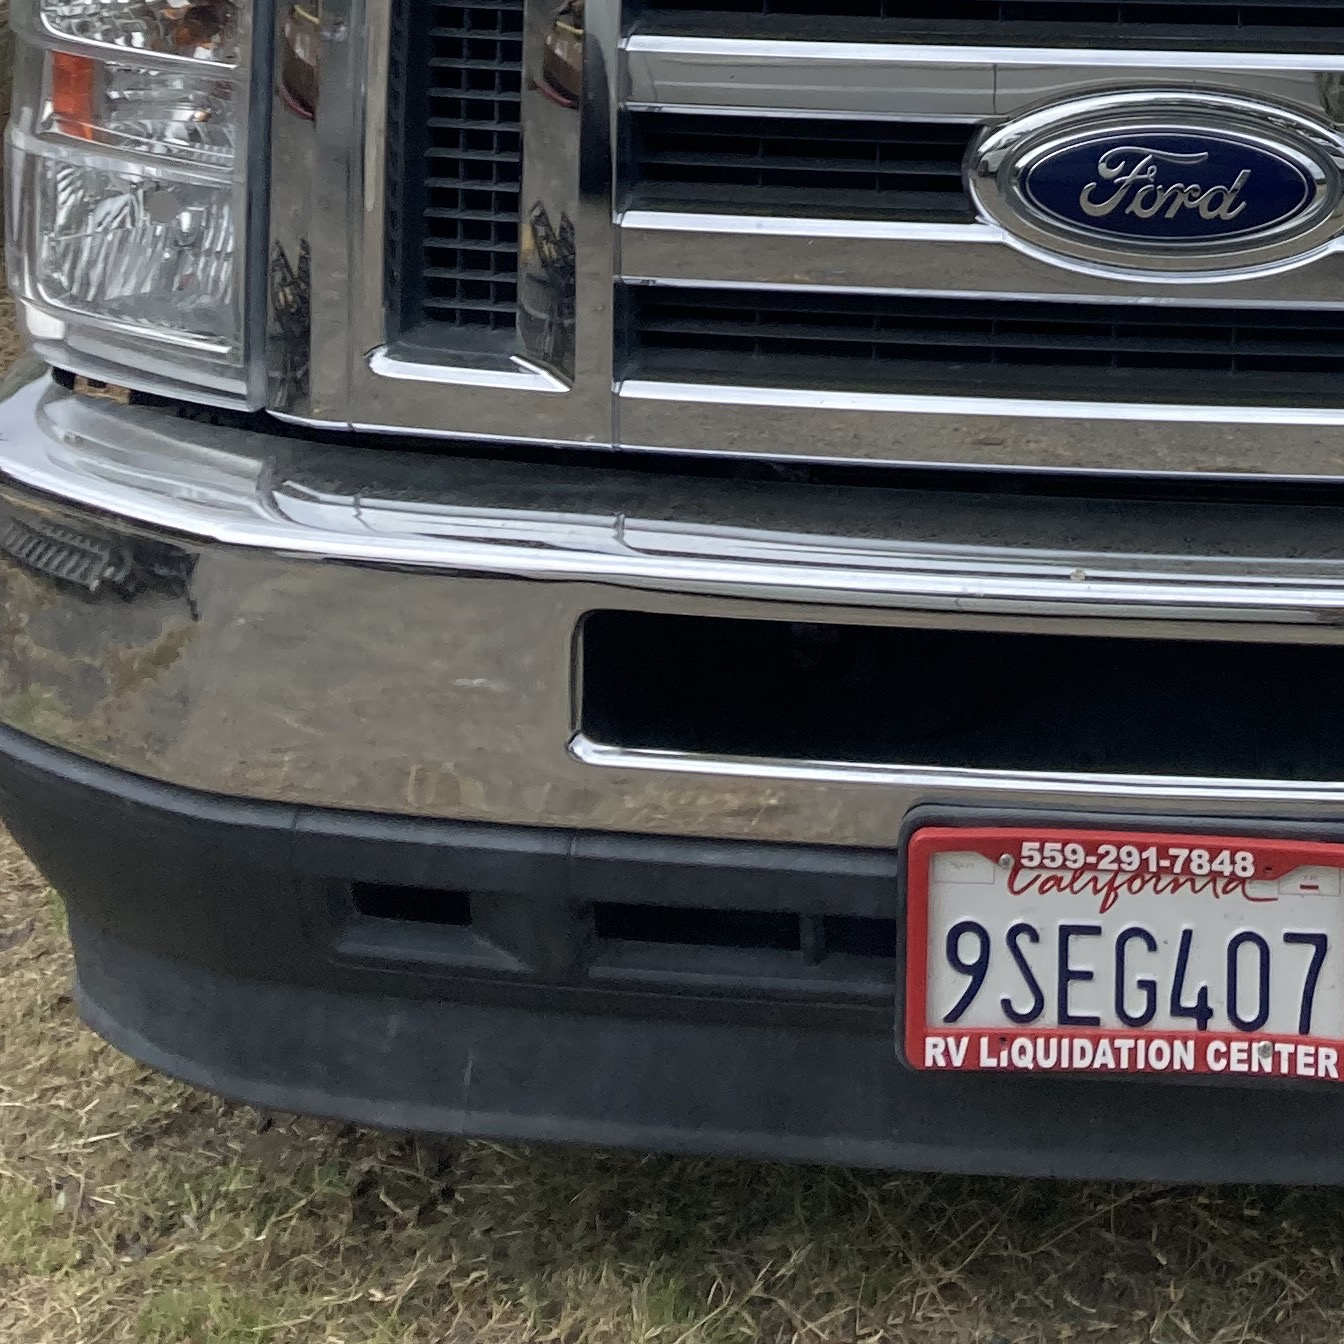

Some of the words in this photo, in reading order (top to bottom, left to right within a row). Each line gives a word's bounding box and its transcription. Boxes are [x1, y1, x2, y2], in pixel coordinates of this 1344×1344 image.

[1078, 145, 1252, 221] Ford
[1020, 841, 1256, 878] 559-291-7848
[942, 920, 1330, 1036] 9SEG407
[924, 1036, 969, 1068] RV
[979, 1037, 1196, 1072] LIQUIDATION
[1206, 1040, 1340, 1079] CENTER
